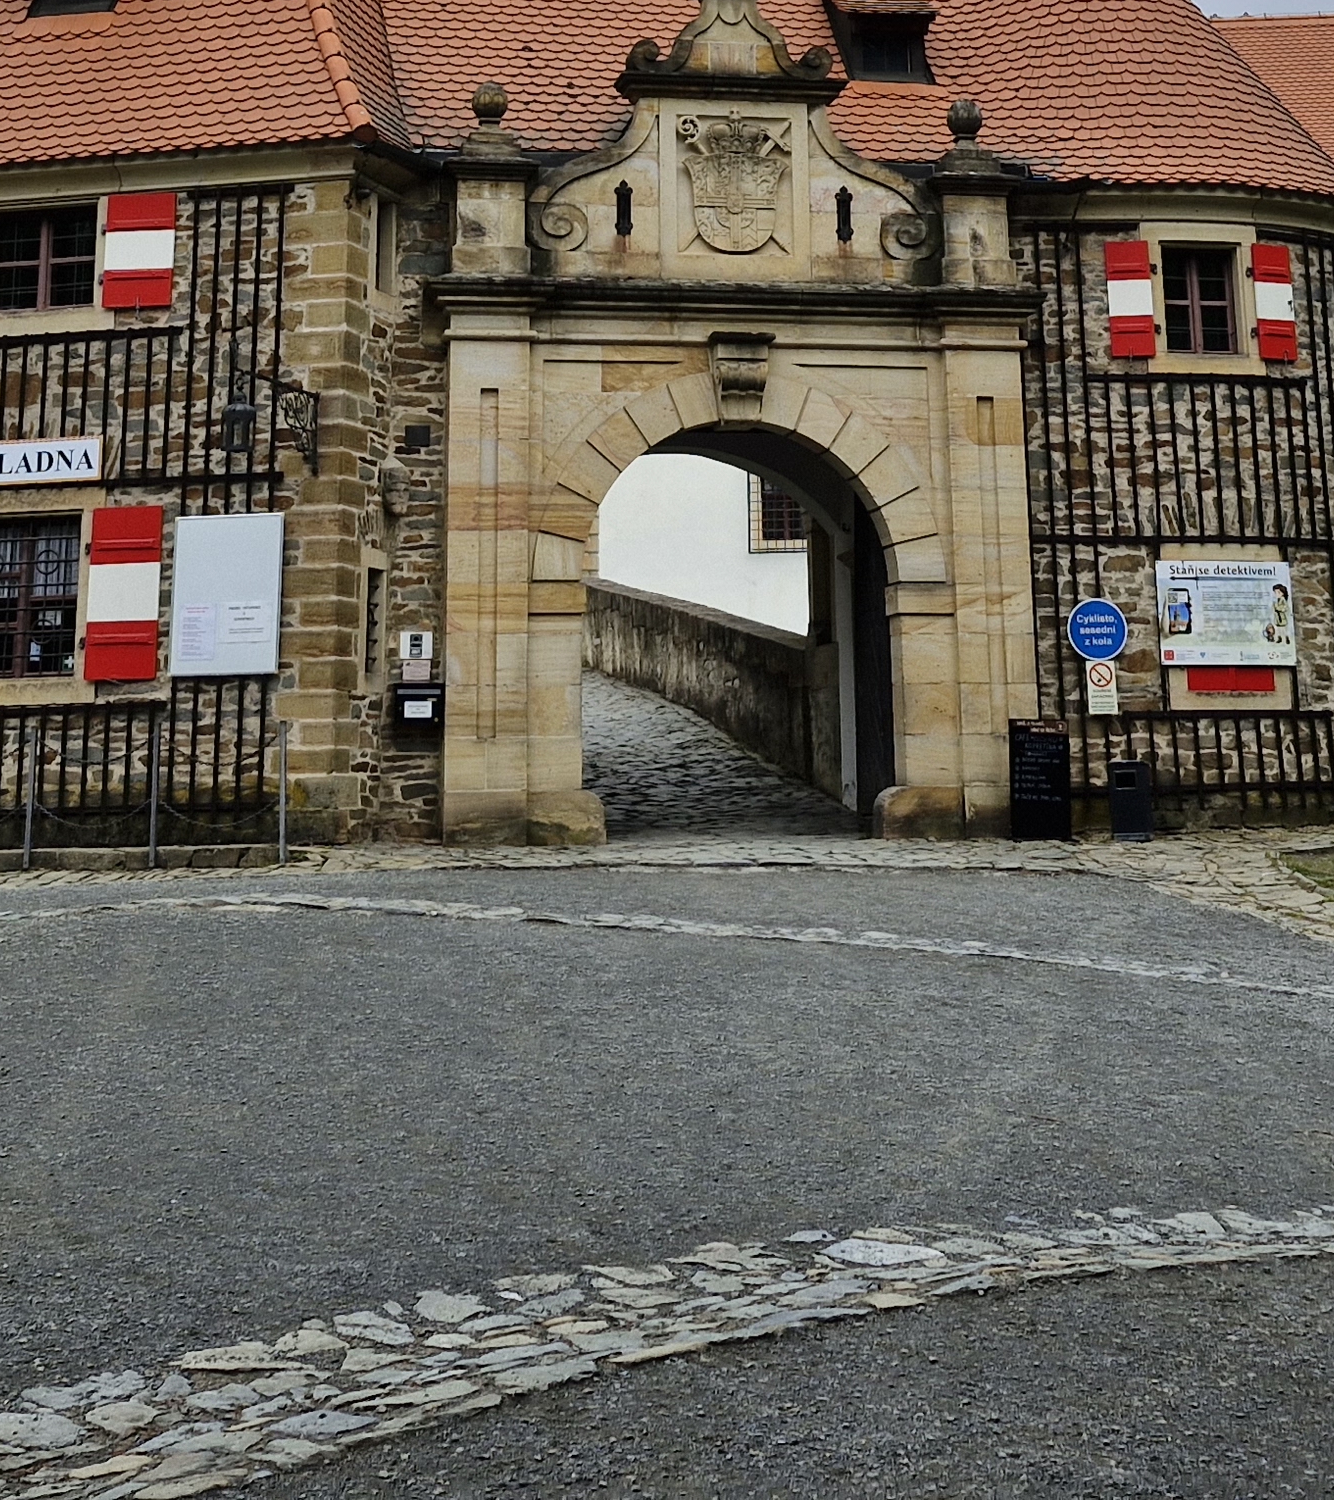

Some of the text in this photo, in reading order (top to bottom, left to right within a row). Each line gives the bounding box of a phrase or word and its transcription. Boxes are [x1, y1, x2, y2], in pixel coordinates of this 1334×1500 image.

[1169, 564, 1277, 576] Staň se detektivem!
[1076, 614, 1118, 625] Cyklisto,
[1079, 625, 1116, 635] sesedni
[1084, 636, 1113, 646] z kola
